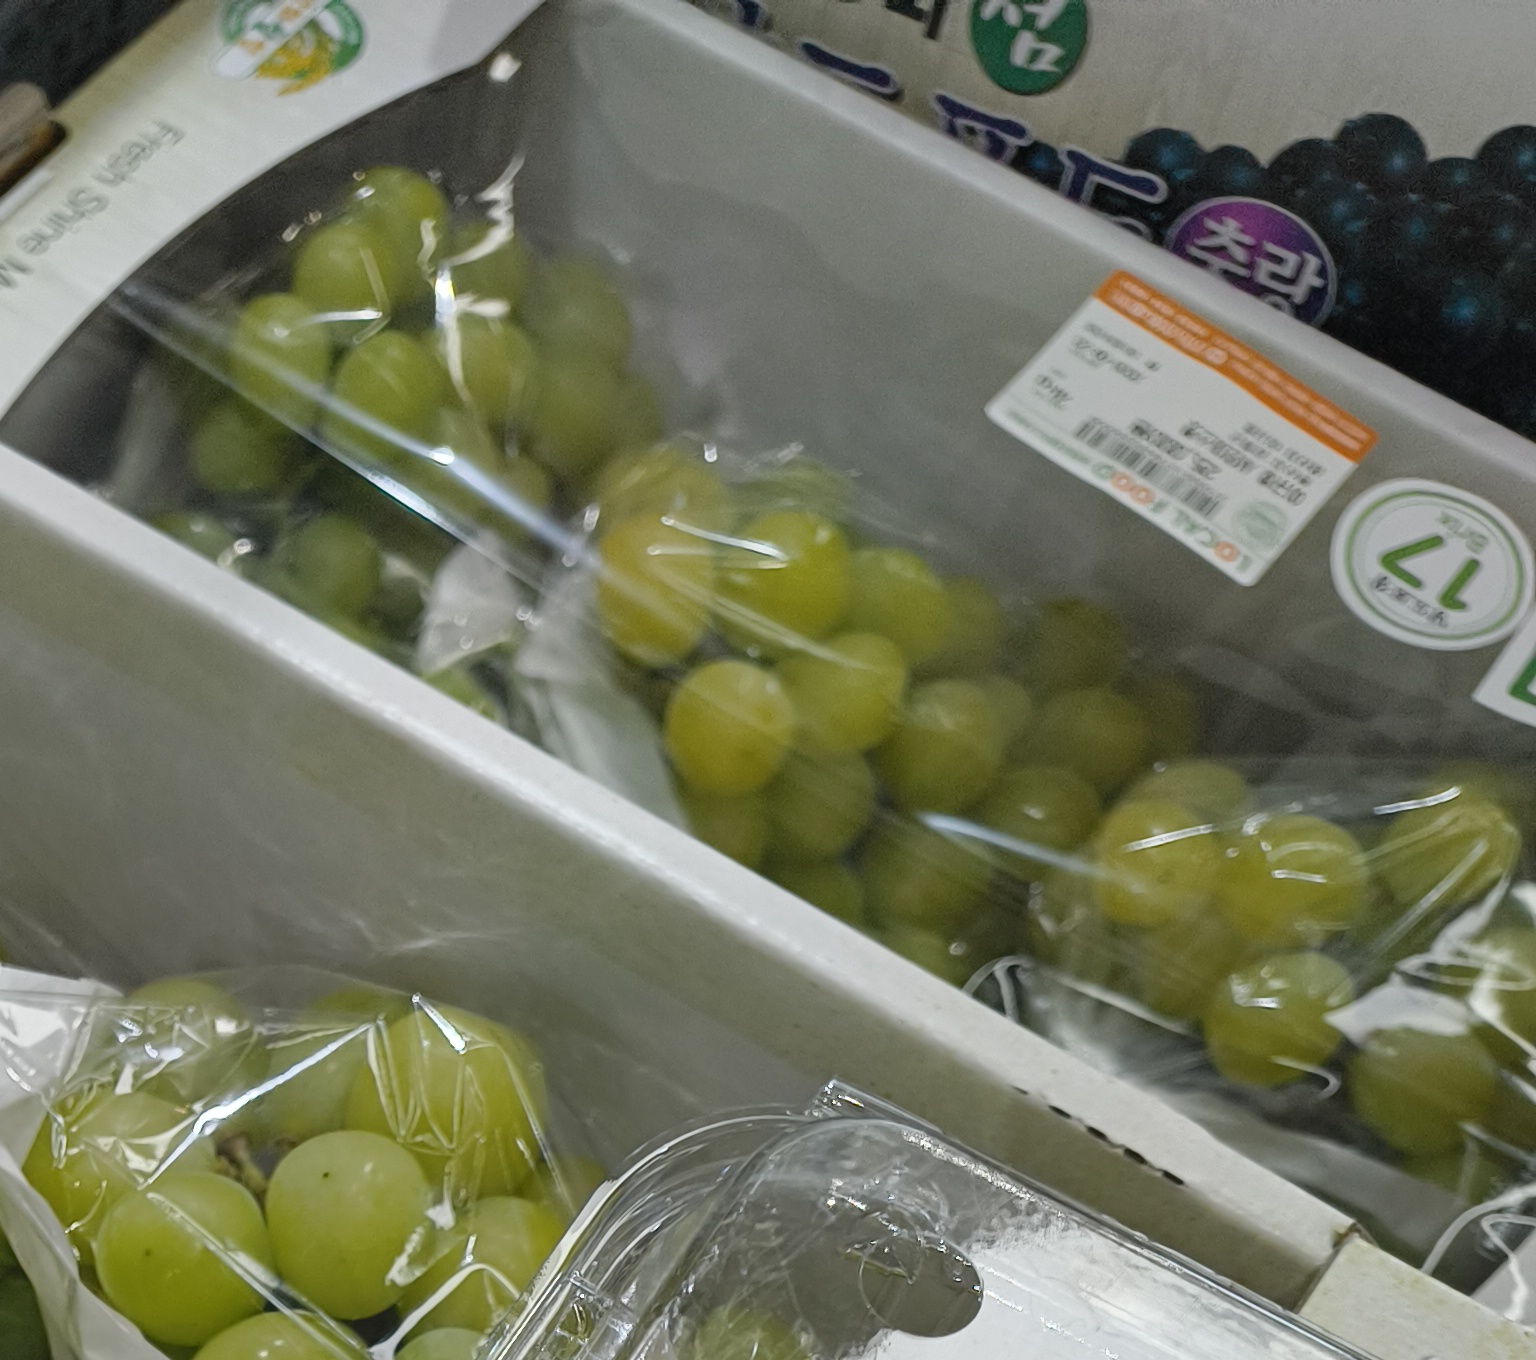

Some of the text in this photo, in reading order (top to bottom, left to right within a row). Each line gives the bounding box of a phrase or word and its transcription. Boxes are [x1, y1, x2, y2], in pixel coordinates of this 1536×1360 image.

[91, 119, 186, 188] Fresh
[16, 186, 109, 256] Shine
[1380, 535, 1480, 610] 17
